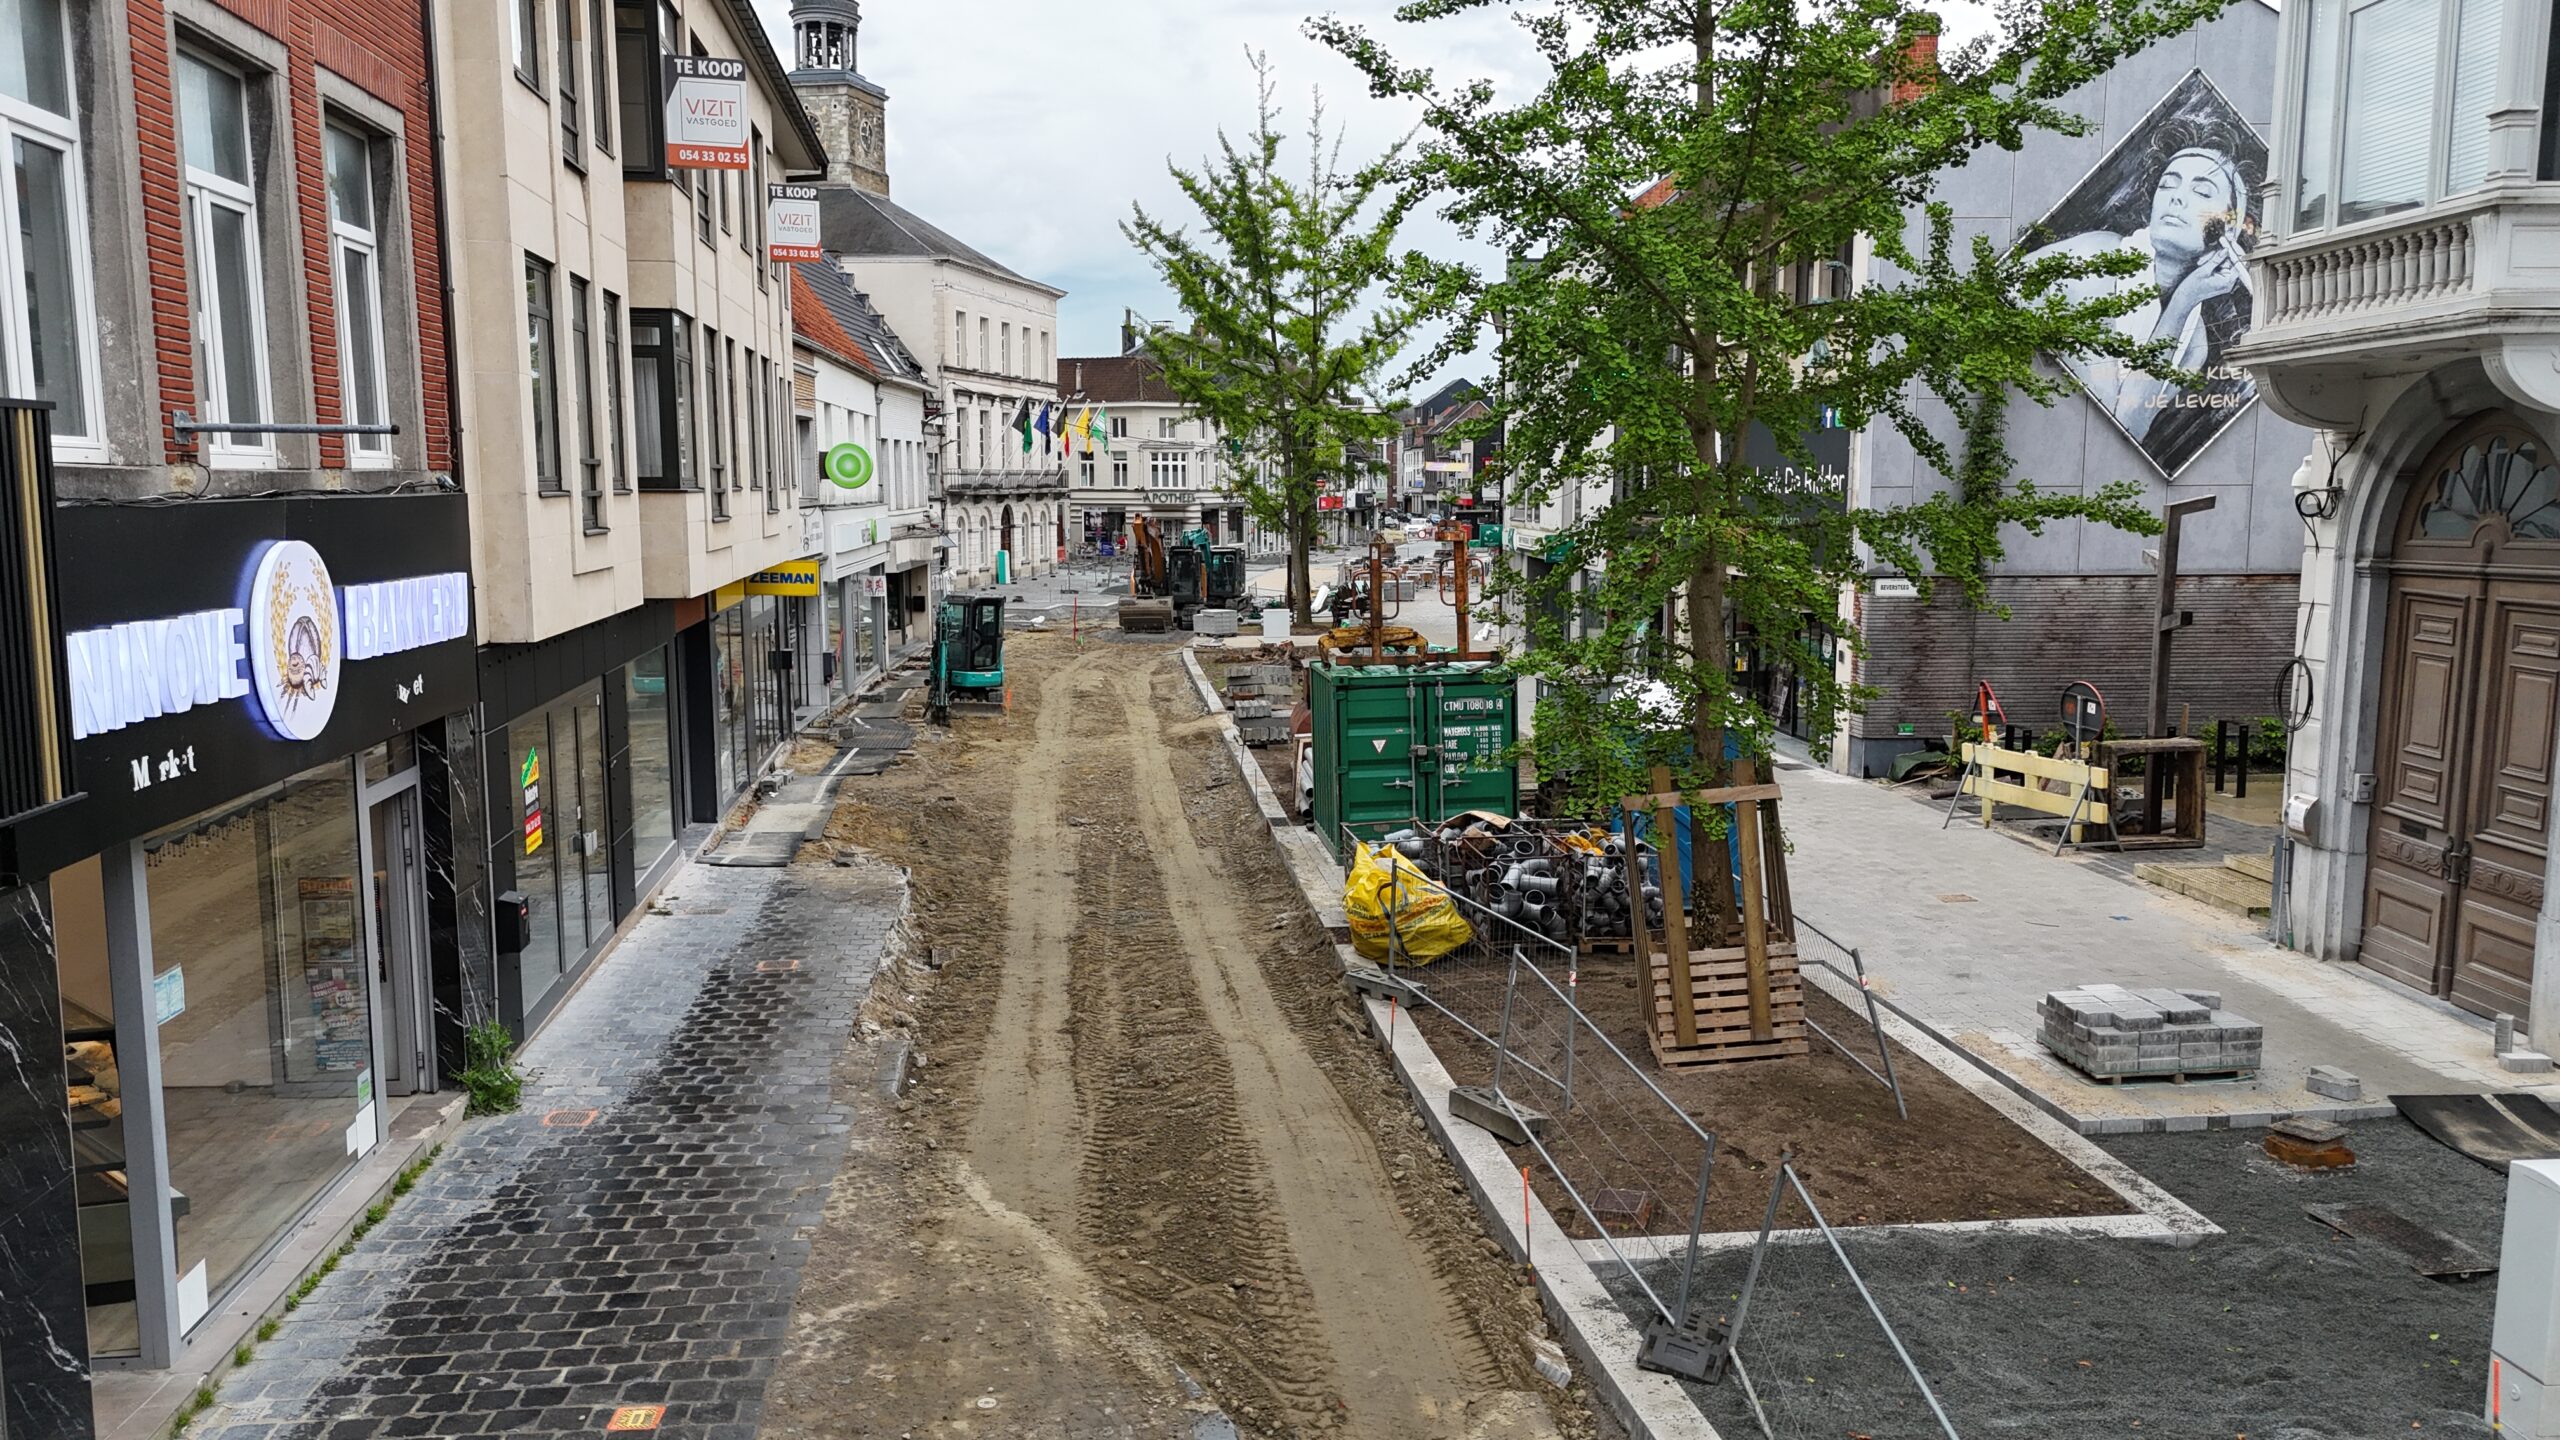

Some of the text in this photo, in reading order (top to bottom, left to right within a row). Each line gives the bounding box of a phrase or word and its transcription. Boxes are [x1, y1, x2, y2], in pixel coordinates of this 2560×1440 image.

[674, 58, 743, 78] TE KOOP
[685, 97, 737, 118] VIZIT
[686, 117, 738, 128] VASTGOED
[679, 149, 747, 164] 054 33 02 55
[770, 185, 818, 199] TE KOOP
[777, 212, 813, 227] VIZIT
[773, 248, 820, 259] 054 33 02 55
[2144, 393, 2168, 409] JE
[2174, 392, 2241, 409] LEVEN!
[749, 571, 815, 585] ZEEMAN
[344, 571, 469, 660] BAKKERIJ
[66, 608, 250, 740] NINOVE
